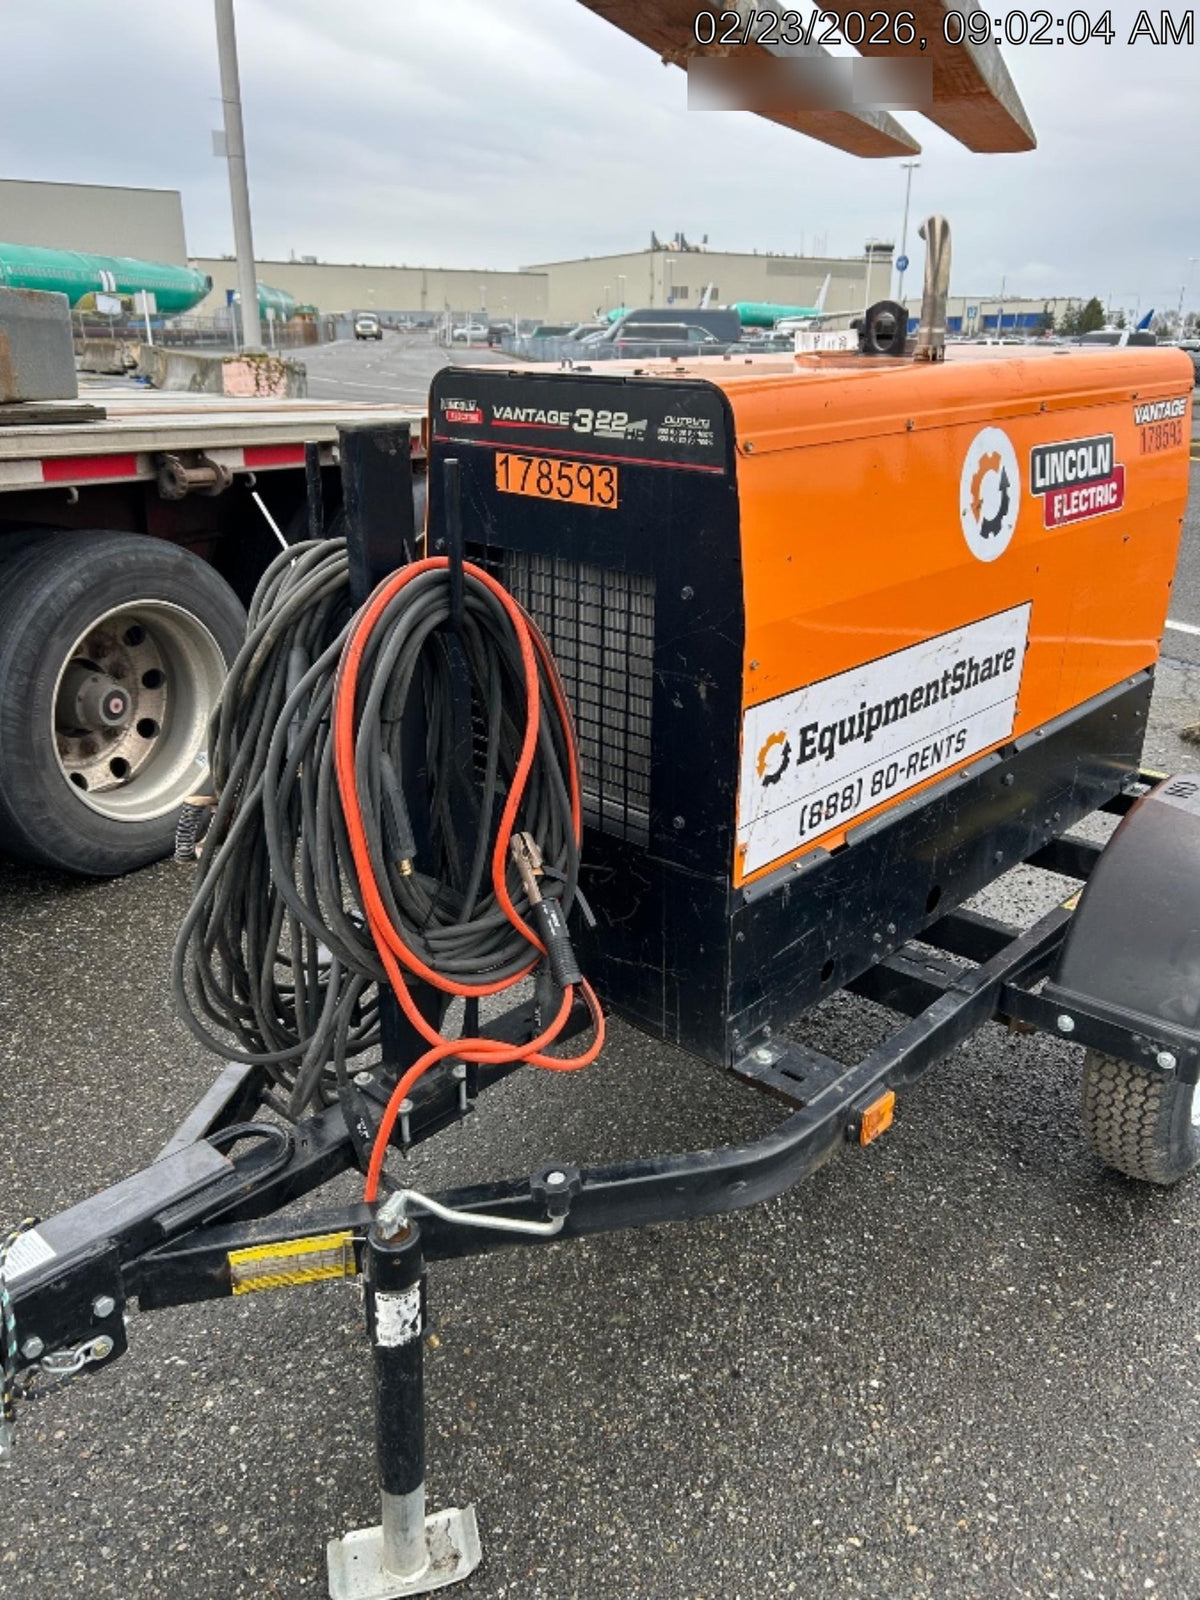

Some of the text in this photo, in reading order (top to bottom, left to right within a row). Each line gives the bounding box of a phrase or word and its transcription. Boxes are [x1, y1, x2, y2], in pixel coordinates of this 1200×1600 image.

[492, 405, 571, 424] VANTAGE
[1134, 397, 1188, 425] VANTAGE
[1141, 420, 1182, 453] 178593
[499, 454, 615, 505] 178593
[1034, 443, 1111, 488] LINCOLN
[1053, 481, 1118, 519] ELECTRIC
[796, 646, 1016, 765] EquipmentShare
[798, 728, 968, 836] (888) 80-RENTS
